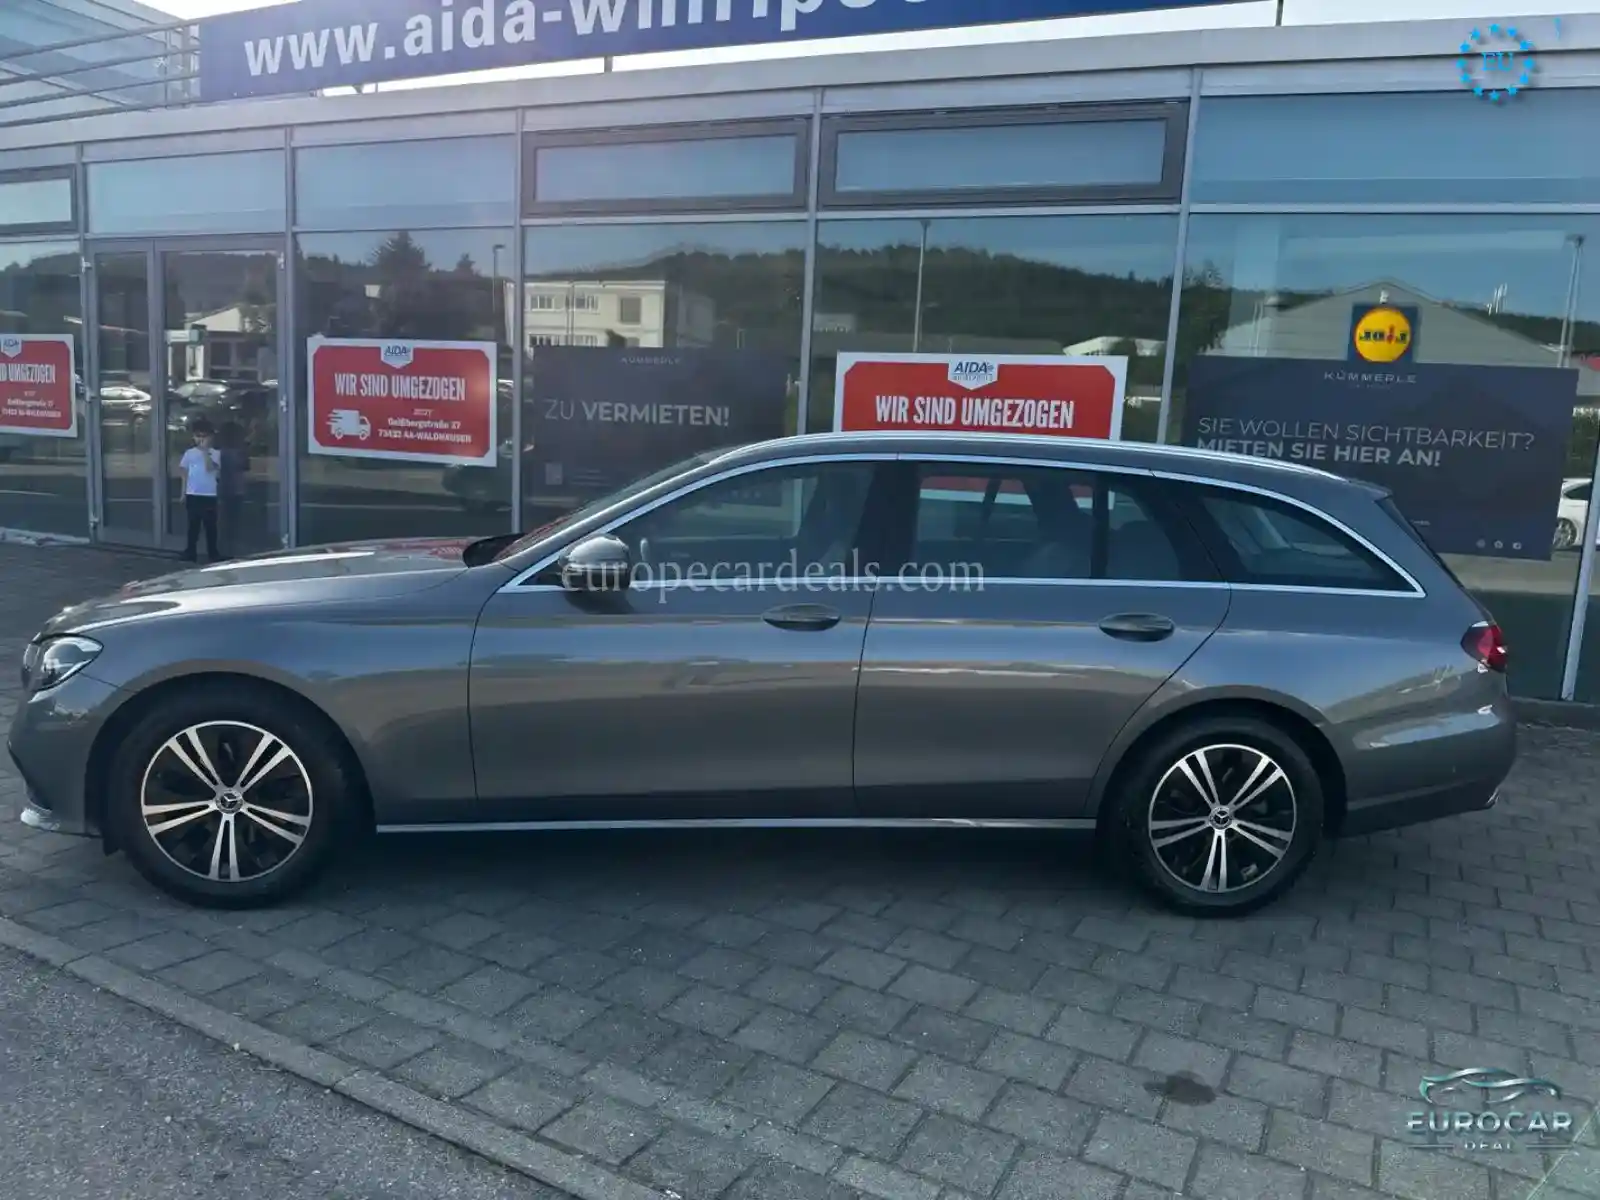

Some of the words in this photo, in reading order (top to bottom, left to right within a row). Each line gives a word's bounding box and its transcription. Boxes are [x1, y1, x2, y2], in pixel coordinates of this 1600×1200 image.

[953, 361, 988, 374] AIDA
[334, 372, 357, 395] WIR
[360, 375, 389, 398] SIND
[391, 375, 466, 401] UMGEZOGEN
[544, 399, 575, 421] ZU
[581, 401, 730, 427] VERMIETEN!
[875, 395, 909, 424] WIR
[913, 396, 956, 425] SIND
[961, 398, 1074, 429] UMGEZOGEN
[1198, 416, 1232, 435] SIE
[1239, 419, 1340, 441] WOLLEN
[1346, 424, 1535, 450] SICHTBARKEIT?
[1291, 443, 1326, 461] SIE
[1334, 445, 1391, 465] HIER
[1396, 448, 1441, 467] AN!
